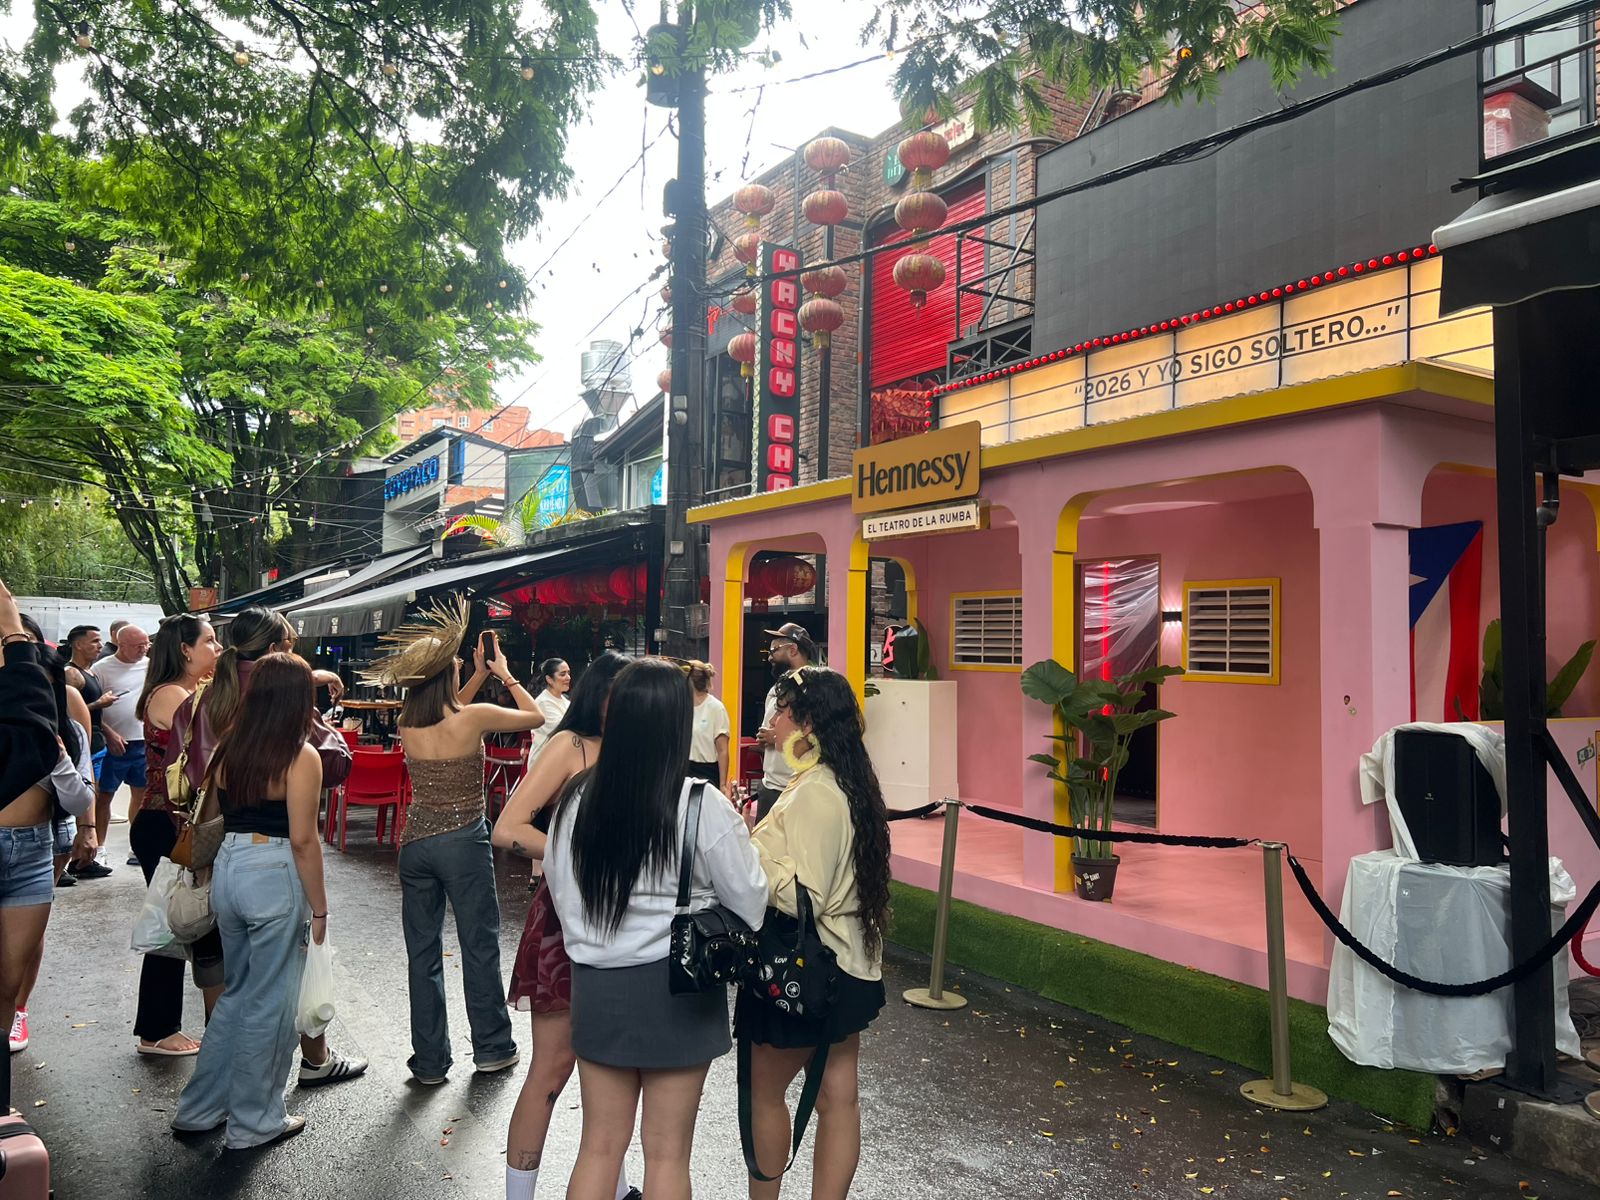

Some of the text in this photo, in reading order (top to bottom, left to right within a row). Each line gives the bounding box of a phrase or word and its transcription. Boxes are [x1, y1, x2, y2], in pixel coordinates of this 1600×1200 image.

[1138, 367, 1150, 386] Y
[1157, 359, 1182, 382] YO
[1190, 345, 1242, 374] SIGO
[857, 450, 970, 498] Hennessy
[867, 510, 971, 534] EL TEATRO DE LA RUMBA
